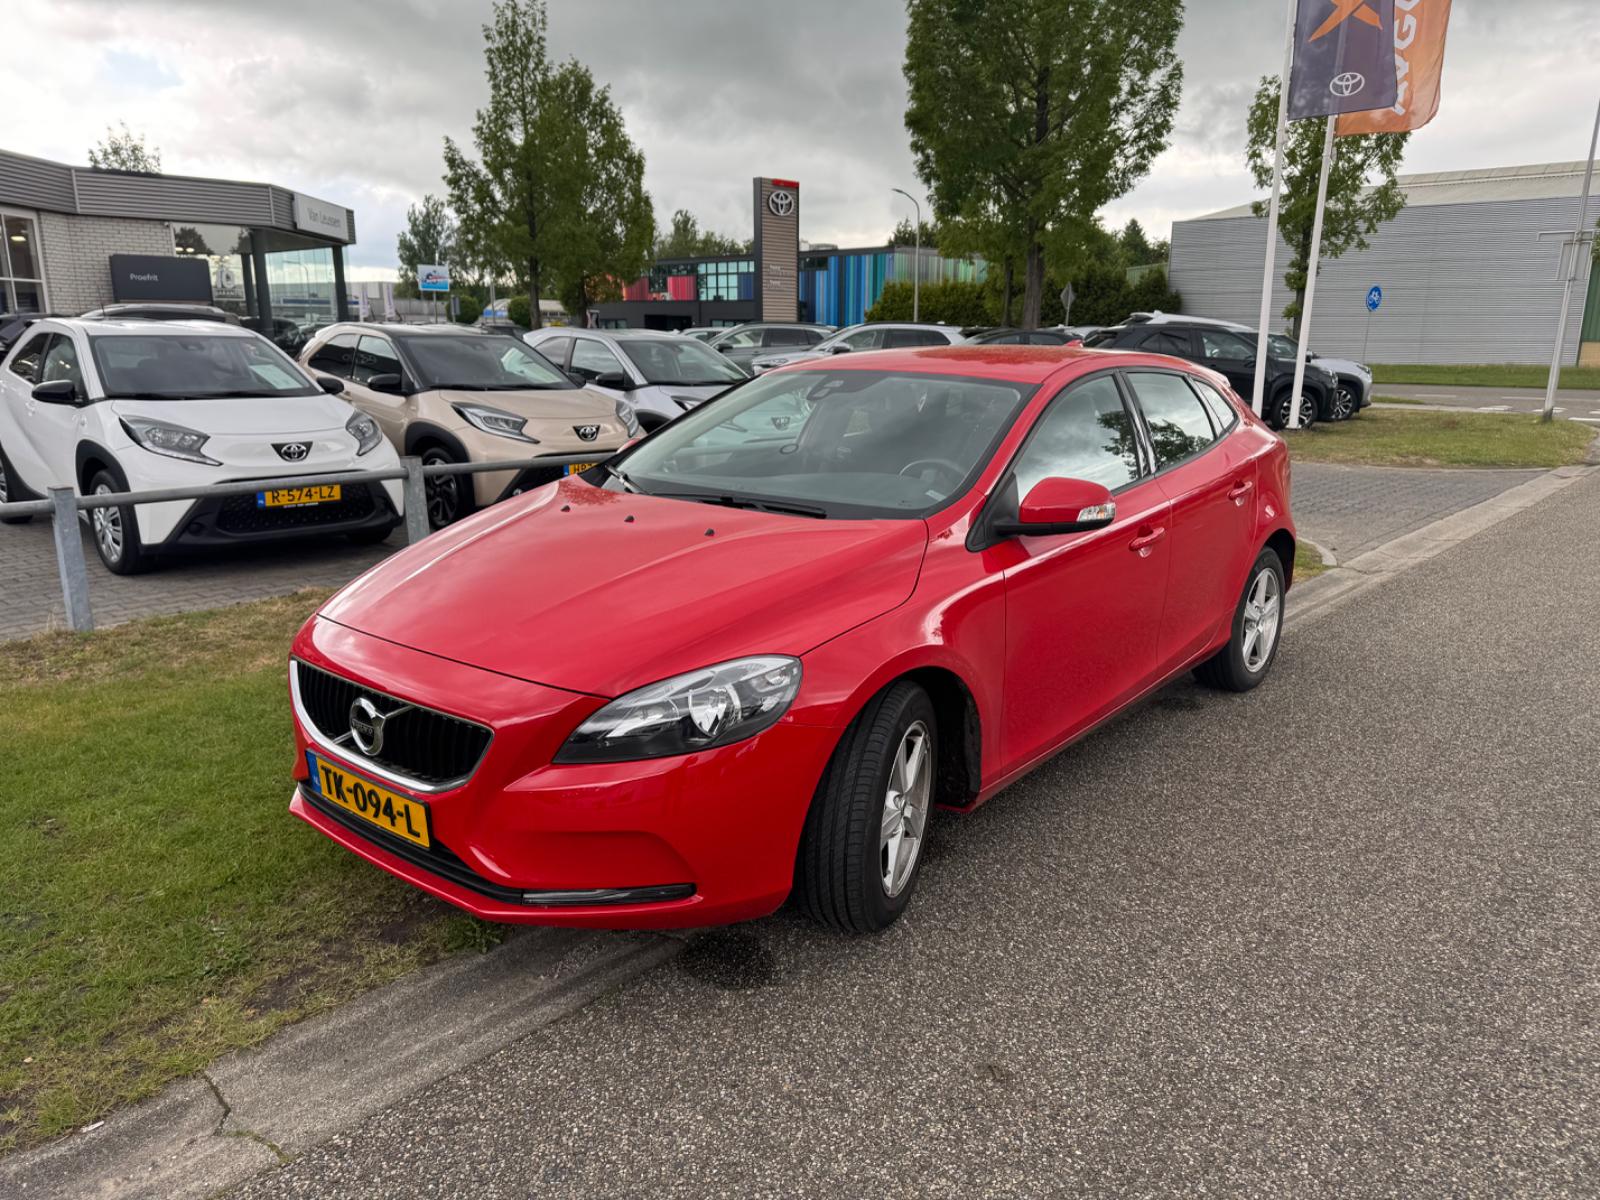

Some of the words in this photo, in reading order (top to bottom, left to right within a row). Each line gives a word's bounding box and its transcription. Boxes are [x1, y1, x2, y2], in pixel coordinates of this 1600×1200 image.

[129, 272, 159, 282] Proefrit
[271, 486, 335, 503] R-574-LZ
[320, 764, 421, 838] TK-094-L
